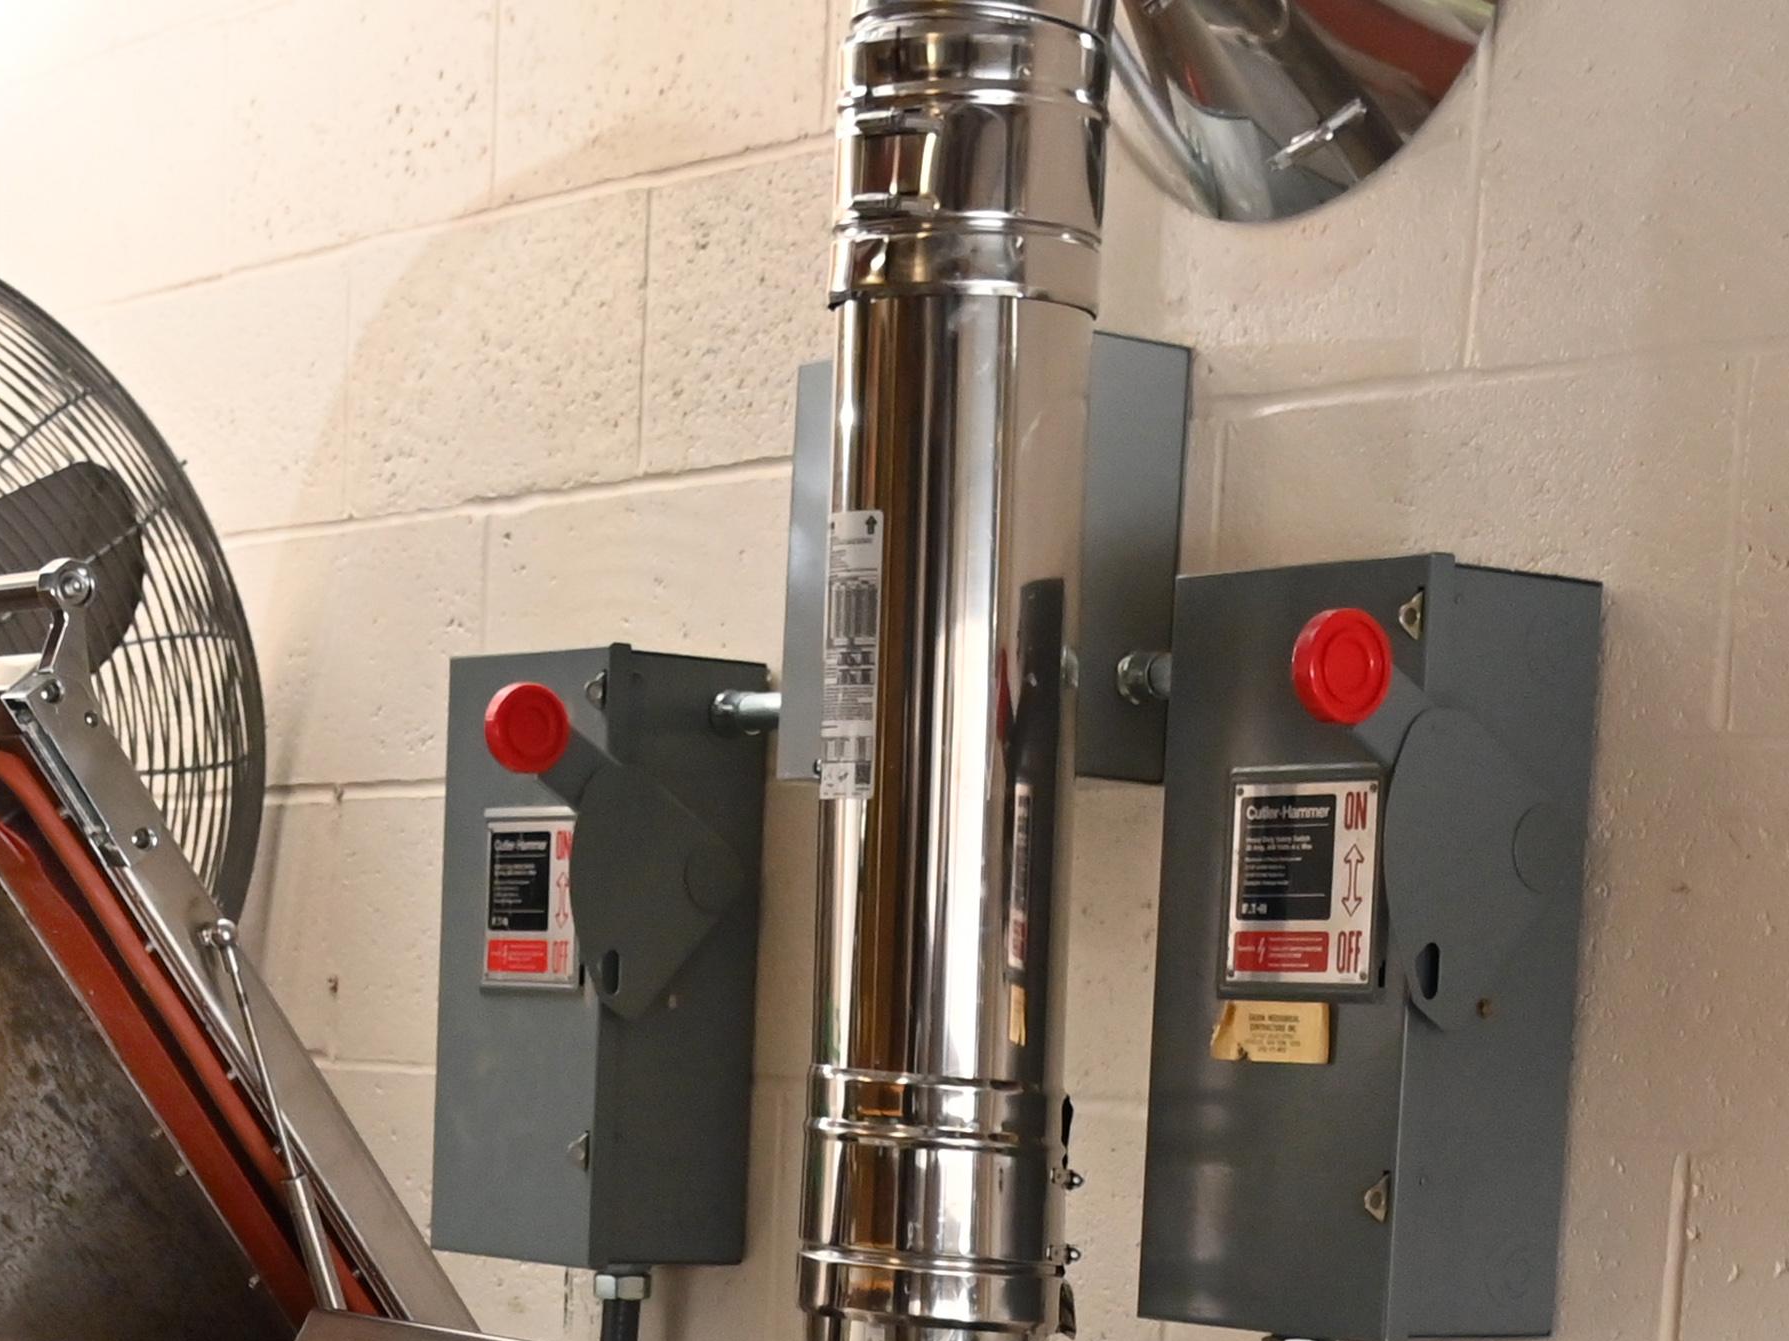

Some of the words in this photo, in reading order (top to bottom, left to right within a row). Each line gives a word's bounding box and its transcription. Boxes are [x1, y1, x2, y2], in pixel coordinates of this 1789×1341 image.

[1246, 805, 1331, 820] Cutler-Hammer
[1344, 791, 1368, 831] ON
[1336, 930, 1363, 974] OFF
